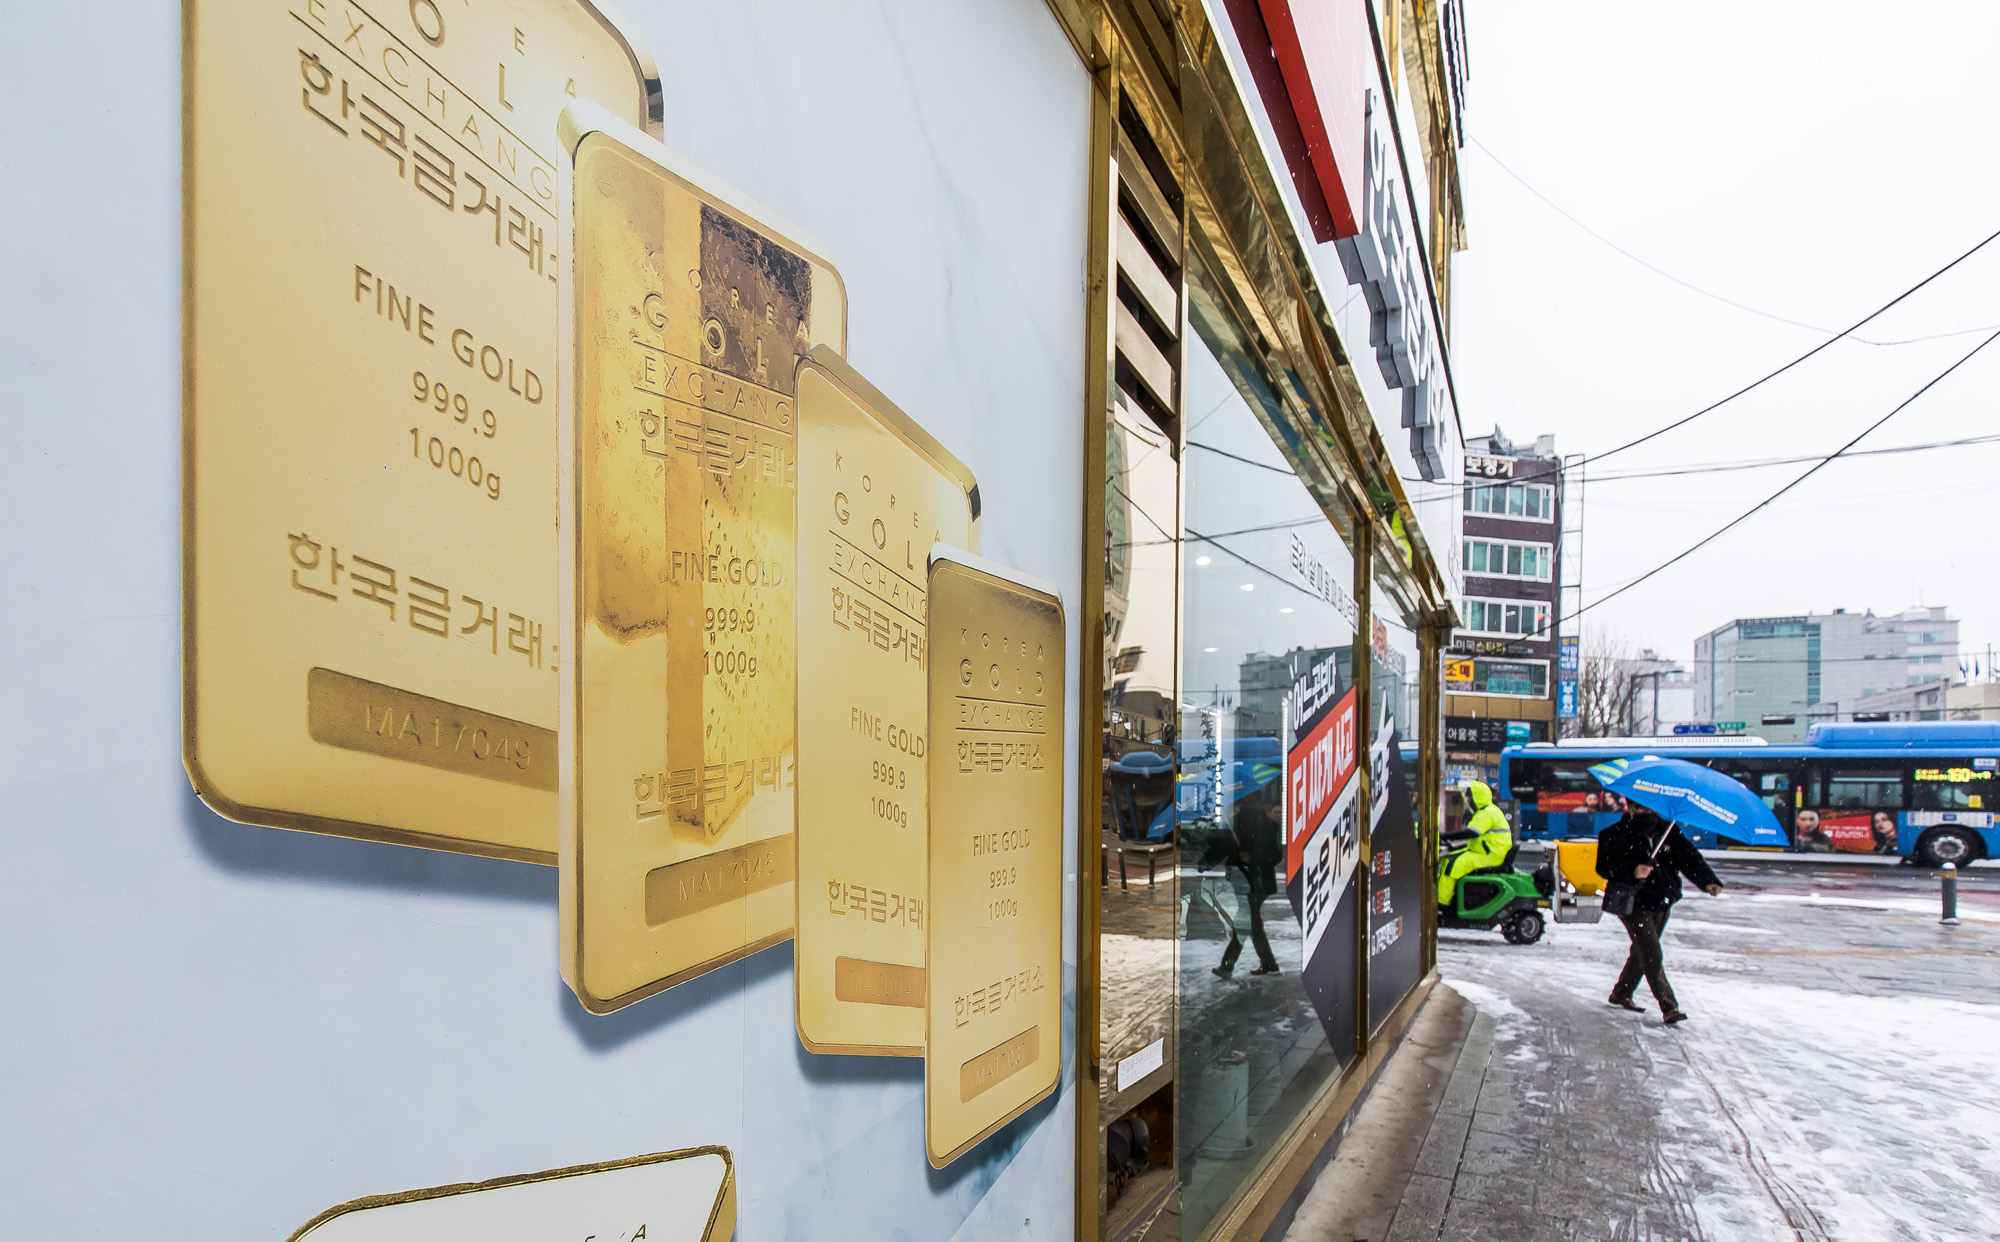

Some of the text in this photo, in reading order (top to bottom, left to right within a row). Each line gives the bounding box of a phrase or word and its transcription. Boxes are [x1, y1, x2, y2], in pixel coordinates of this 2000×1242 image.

[307, 0, 554, 200] EXCHANG
[297, 47, 557, 283] 한국금거래
[354, 263, 544, 405] FINE GOLD
[642, 292, 769, 375] GOL
[412, 371, 498, 439] 999.9
[643, 356, 791, 426] EXCHANG
[409, 427, 501, 501] 1000g
[834, 491, 914, 571] GOL
[670, 551, 783, 588] FINE GOLD
[286, 531, 559, 673] 한국금거래
[705, 606, 756, 633] 999.9
[832, 586, 927, 672] 한국금거래
[960, 626, 1044, 662] KOREA
[702, 650, 758, 679] 1000g
[959, 658, 1045, 696] GOLD
[851, 706, 925, 759] FINE GOLD
[960, 703, 1044, 729] EXCHANGE
[872, 760, 906, 790] 999.9
[957, 740, 1045, 774] 한국금거래소
[1292, 704, 1355, 843] 더 싸게 사고
[871, 796, 907, 829] 1000g
[973, 828, 1032, 857] FINE GOLD
[989, 866, 1017, 889] 999.9
[1306, 836, 1331, 940] 높은
[828, 878, 924, 931] 한국금거래
[988, 898, 1018, 921] 1000g
[954, 964, 1046, 1031] 한국금거래소
